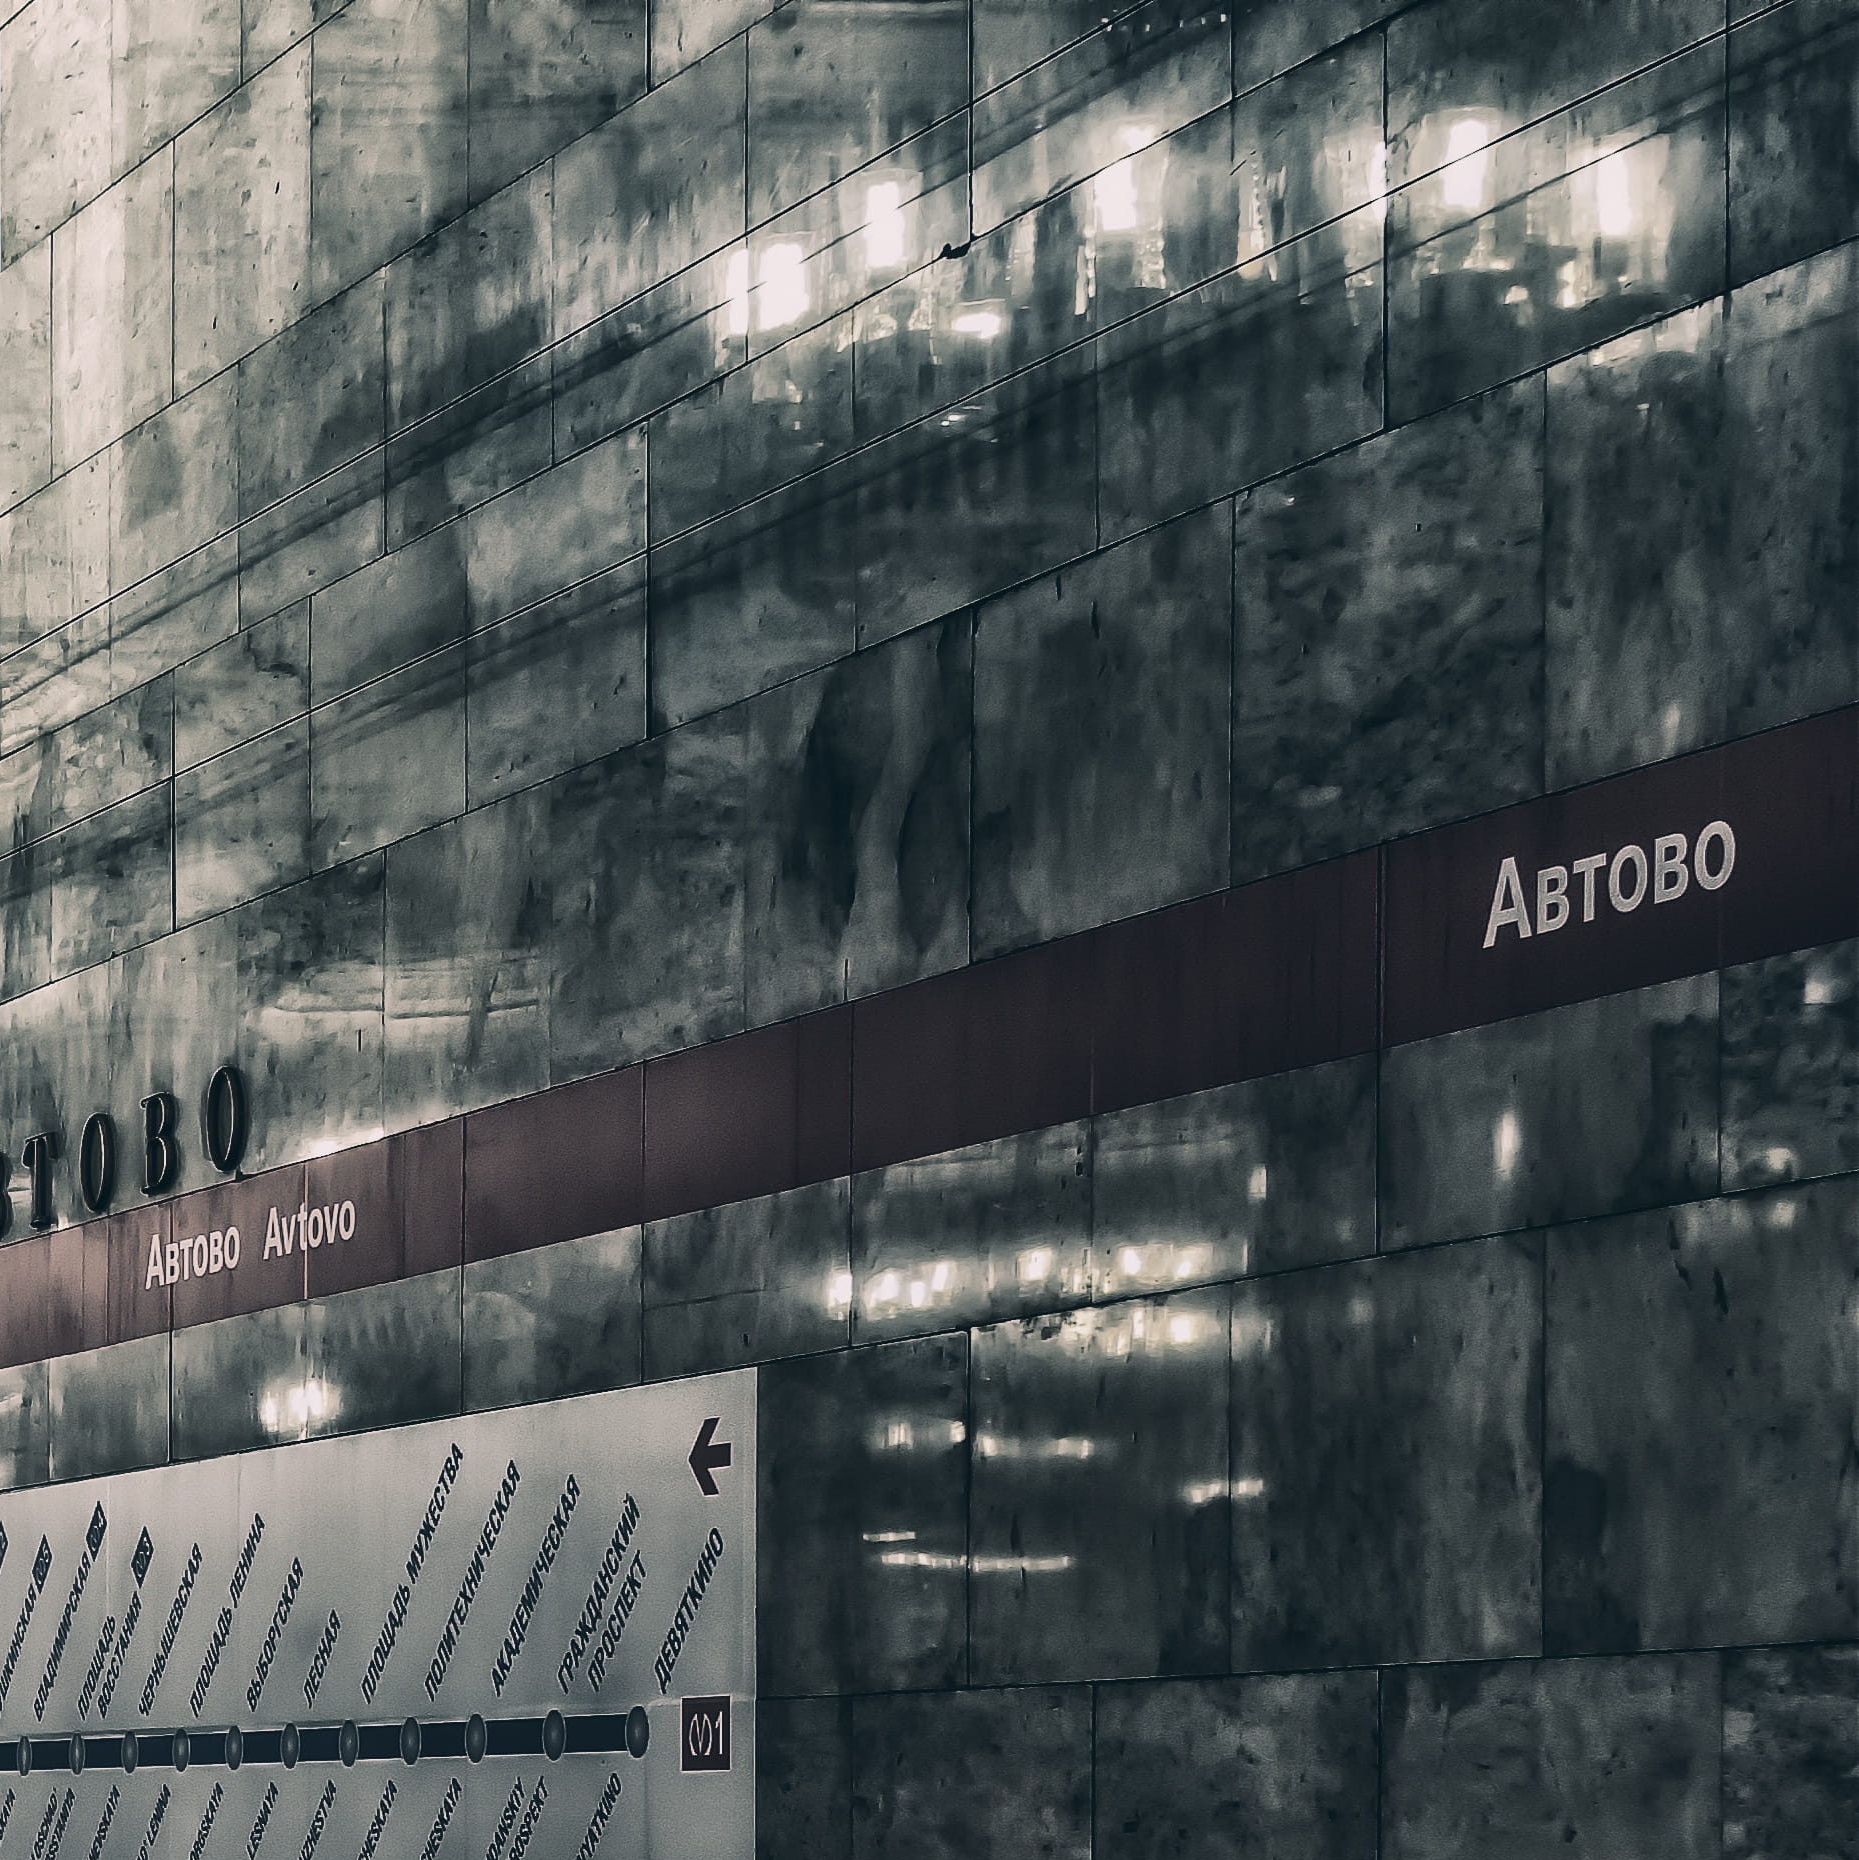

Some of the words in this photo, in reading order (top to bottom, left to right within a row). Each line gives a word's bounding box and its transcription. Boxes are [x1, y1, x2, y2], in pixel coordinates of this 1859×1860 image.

[1482, 819, 1737, 949] Автово
[144, 1226, 241, 1291] Автово
[262, 1200, 357, 1261] Avtovo
[33, 1551, 90, 1723] ВЛАДИМИРСКАЯ
[138, 1543, 202, 1716] ЧЕРНЫШЕВСКАЯ
[189, 1607, 232, 1718] ПЛОЩАДЬ
[230, 1513, 265, 1608] ЛЕНИНА
[247, 1556, 303, 1713] ВЫБОРГСКАЯ
[361, 1583, 411, 1705] ПЛОЩАДЬ
[406, 1442, 463, 1584] МУЖЕСТВА
[424, 1459, 520, 1702] ПОЛИТЕХНИЧЕСКАЯ
[491, 1474, 580, 1697] АКАДЕМИЧЕСКАЯ
[557, 1493, 640, 1694] ГРАЖДАНСКИЙ
[587, 1550, 647, 1692] ПРОСПЕКТ
[654, 1527, 724, 1694] ДЕВЯТКИНО
[78, 1616, 116, 1720] ПЛОЩАДЬ
[97, 1590, 142, 1719] ВОССТАНИЯ
[303, 1609, 341, 1710] ЛЕСНАЯ
[147, 1783, 172, 1847] LENINA
[247, 1781, 279, 1860] LESNAYA
